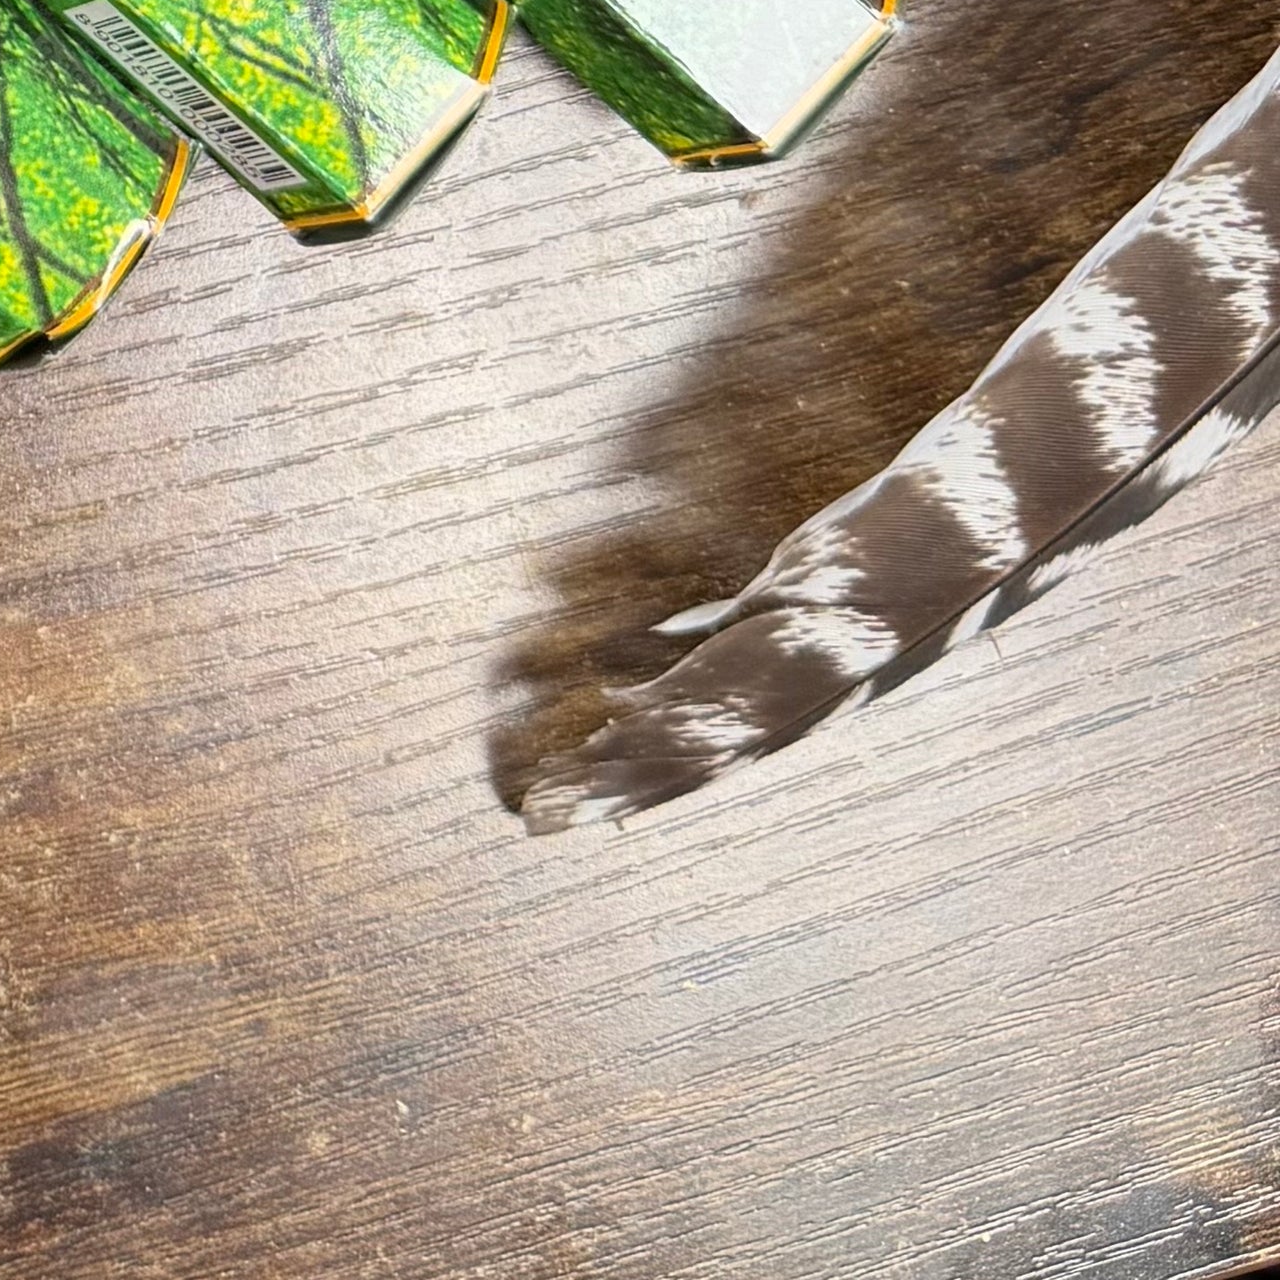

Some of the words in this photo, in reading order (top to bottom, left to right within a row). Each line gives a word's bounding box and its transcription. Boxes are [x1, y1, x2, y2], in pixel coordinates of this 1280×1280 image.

[74, 13, 91, 26] 8
[92, 29, 174, 100] 901810
[179, 108, 259, 179] 000285
